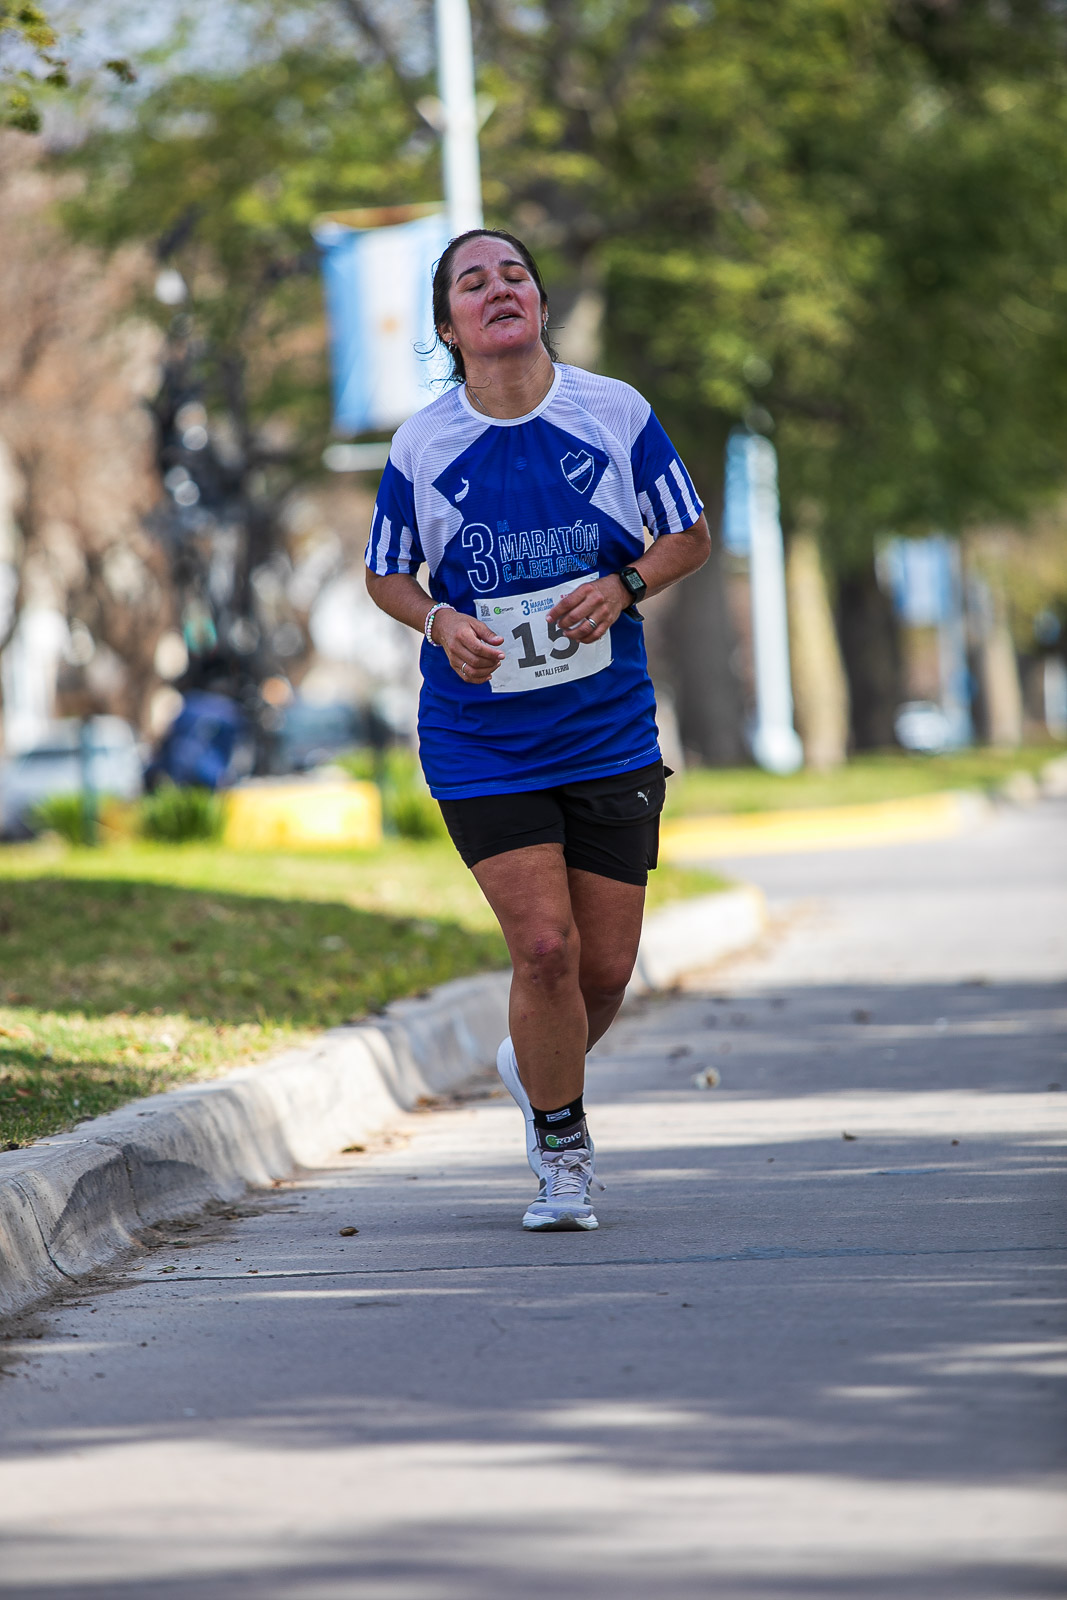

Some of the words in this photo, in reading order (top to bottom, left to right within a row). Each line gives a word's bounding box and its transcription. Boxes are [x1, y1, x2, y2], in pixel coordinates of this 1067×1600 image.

[498, 520, 600, 563] MARATÓN
[461, 523, 499, 593] 3
[520, 599, 530, 616] 3
[534, 667, 554, 678] NATALI
[554, 663, 570, 675] FERRI
